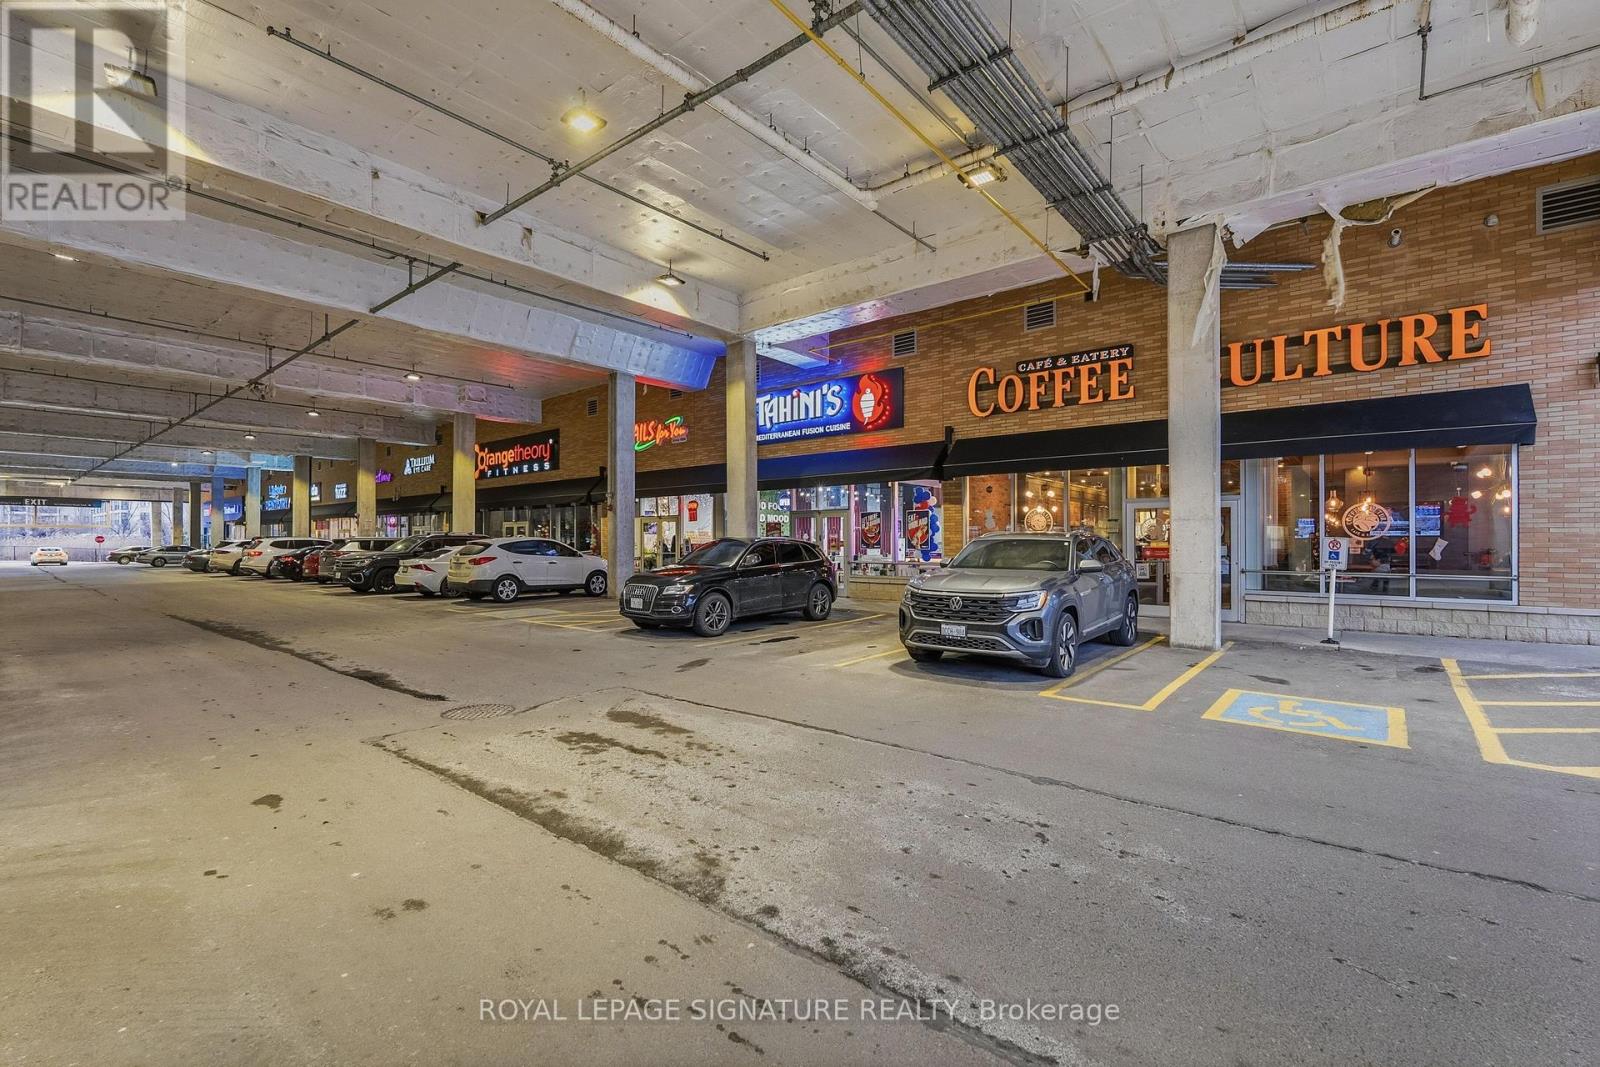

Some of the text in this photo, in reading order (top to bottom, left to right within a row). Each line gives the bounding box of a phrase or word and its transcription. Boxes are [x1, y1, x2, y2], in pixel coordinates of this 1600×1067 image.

[1220, 303, 1492, 387] ULTURE
[1017, 346, 1130, 372] CAFÉ & EATERY
[967, 357, 1135, 418] COFFEE
[656, 424, 669, 445] for
[670, 421, 687, 438] You
[802, 427, 824, 438] FUSION
[825, 421, 851, 433] CUISINE
[487, 461, 550, 478] FITNESS
[24, 498, 47, 506] EXIT
[767, 514, 789, 523] MOOD
